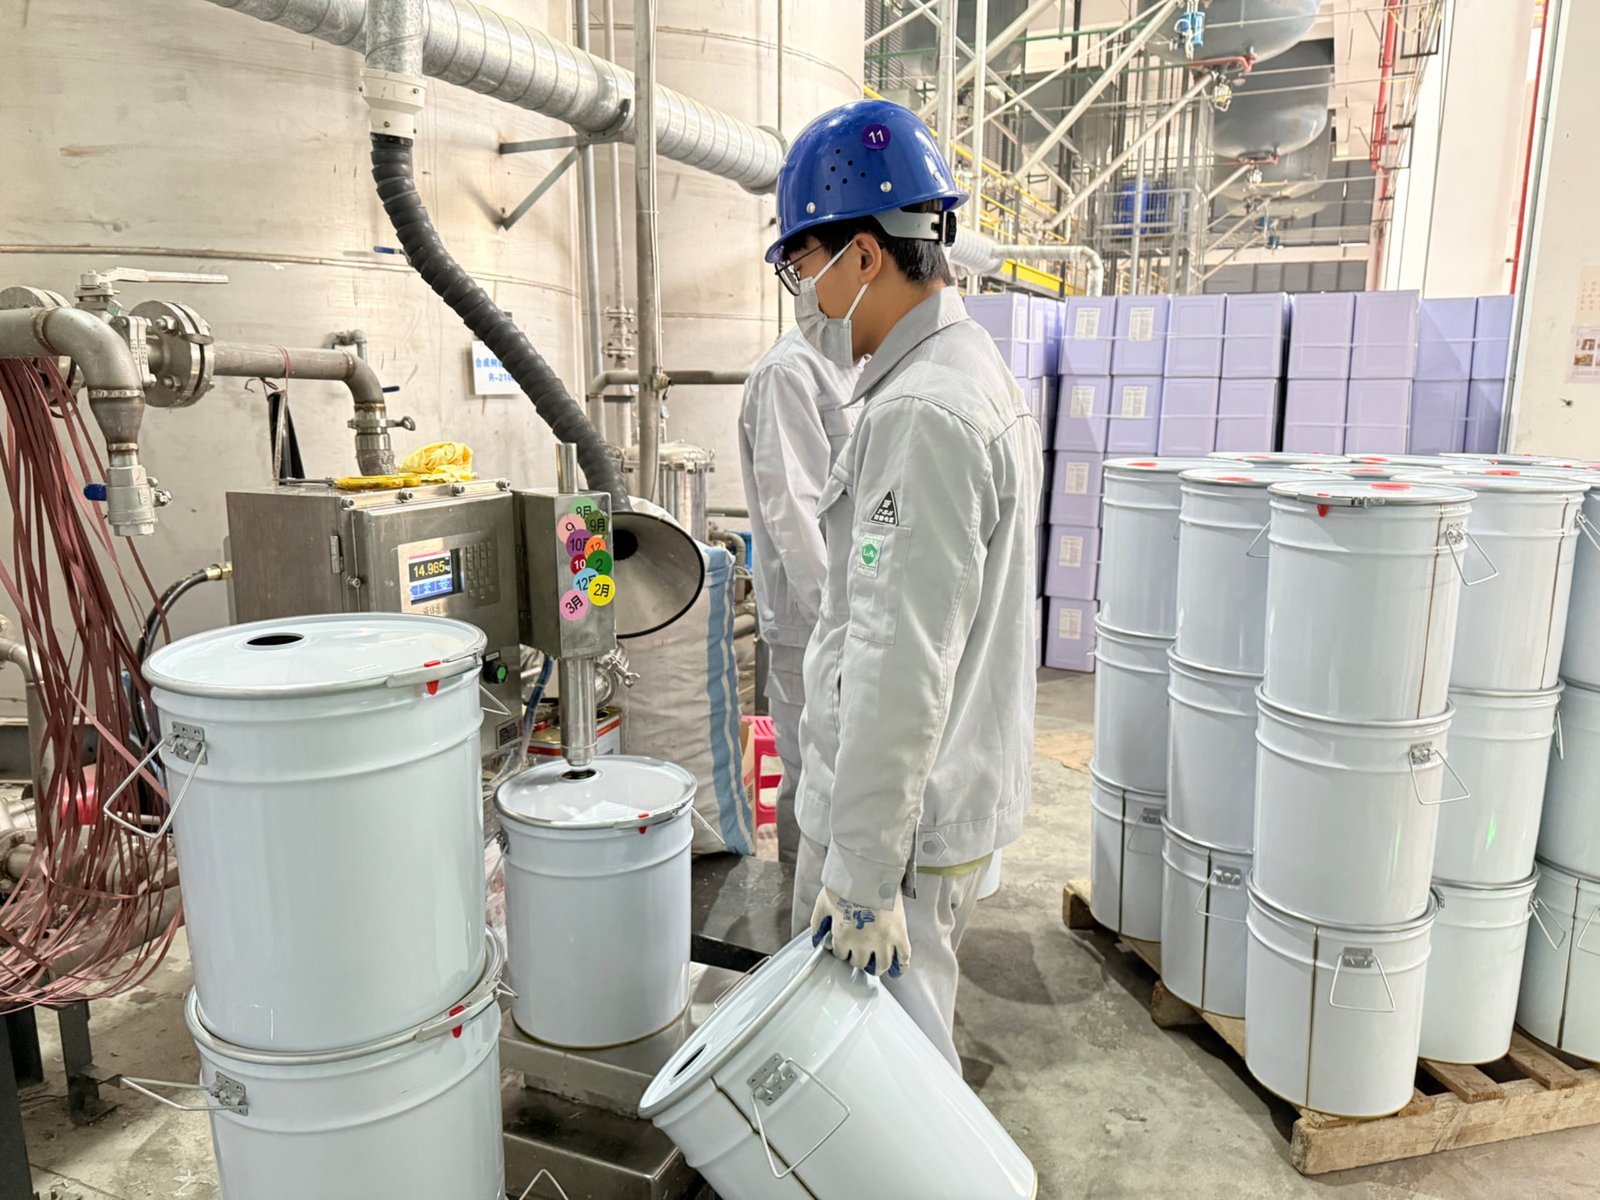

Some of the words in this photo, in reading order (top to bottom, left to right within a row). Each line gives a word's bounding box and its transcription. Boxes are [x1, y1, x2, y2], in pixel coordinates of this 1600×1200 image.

[868, 129, 884, 143] 11
[589, 518, 606, 532] 9月
[413, 560, 445, 578] 14.965
[593, 584, 610, 598] 2月
[565, 595, 583, 614] 3月
